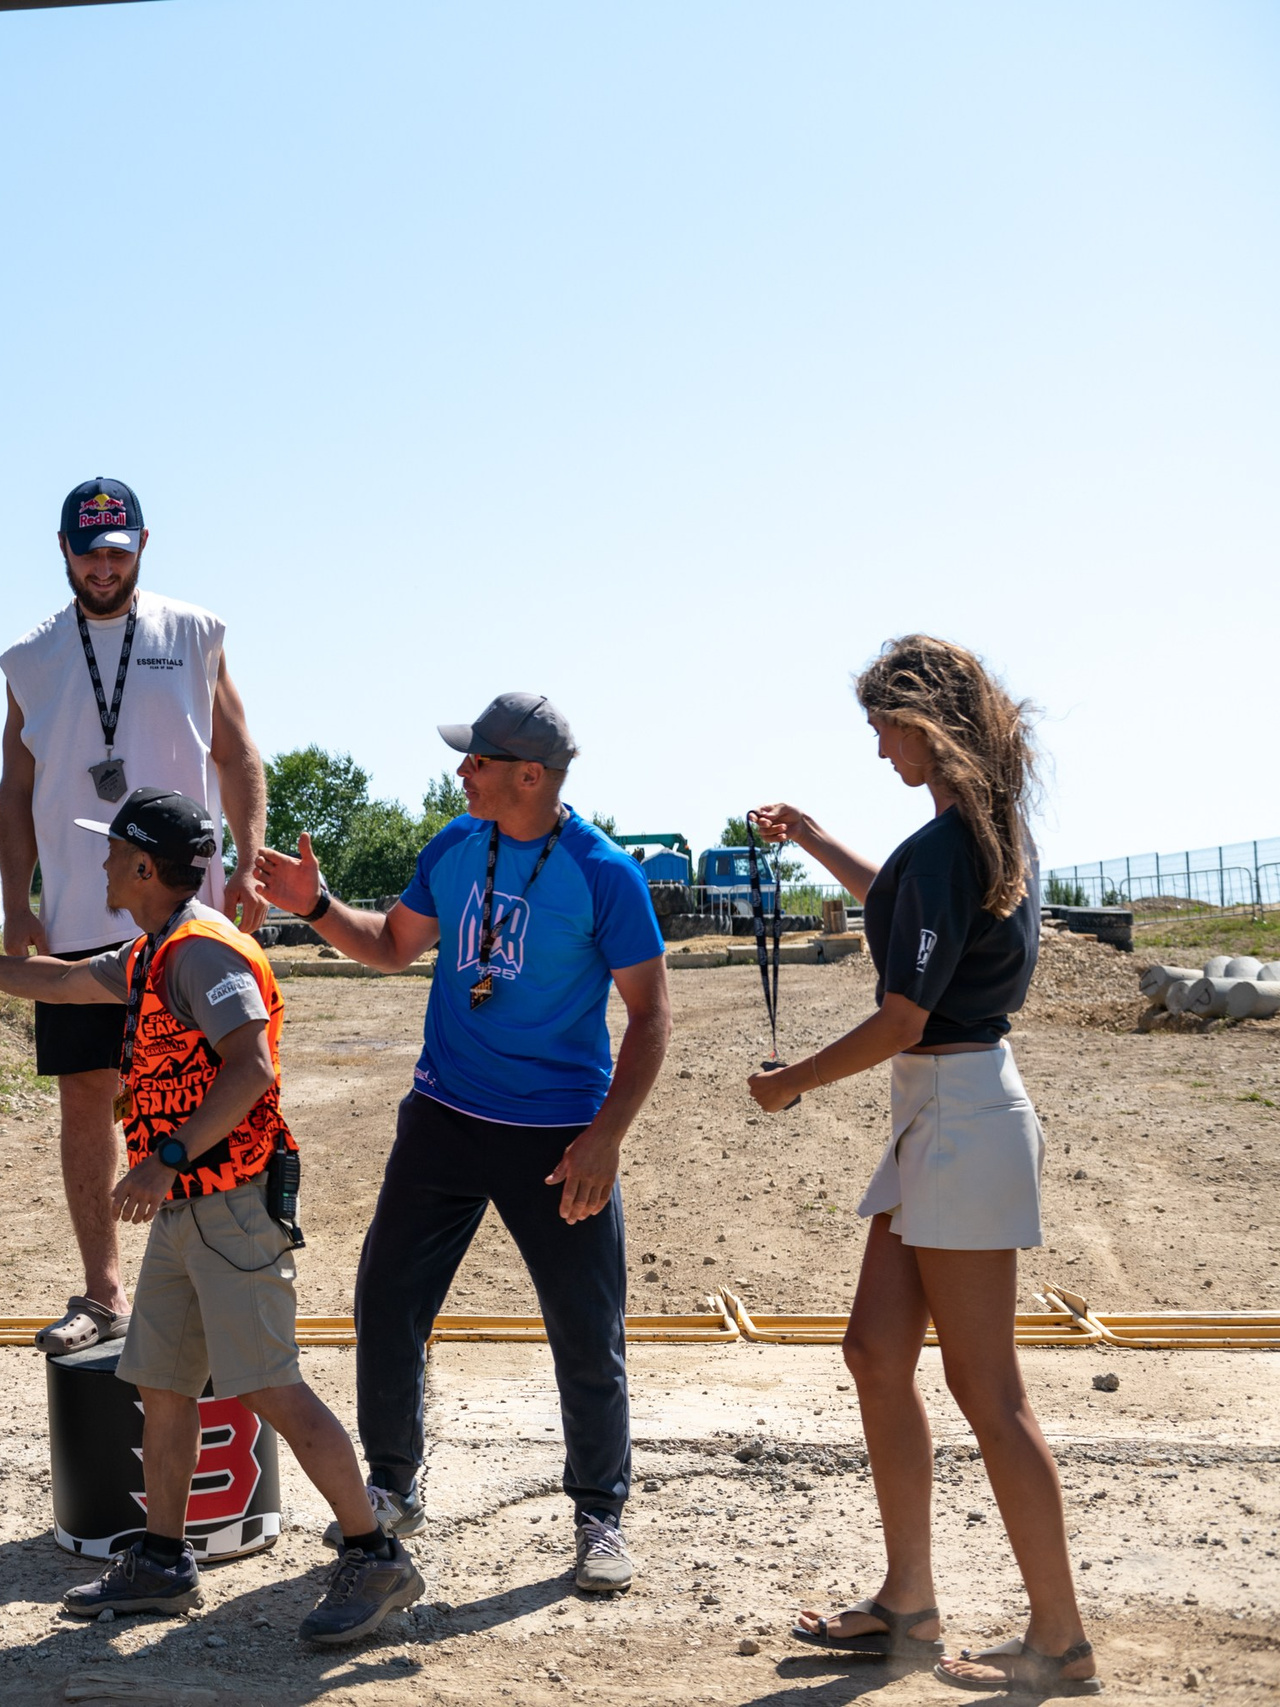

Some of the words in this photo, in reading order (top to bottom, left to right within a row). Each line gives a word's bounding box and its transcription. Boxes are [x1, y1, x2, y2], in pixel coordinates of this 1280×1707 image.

[79, 512, 102, 528] Red
[103, 511, 126, 526] Bull
[136, 658, 183, 666] ESSENTIALS
[148, 1012, 174, 1023] END
[143, 1019, 187, 1038] SAK
[140, 1066, 217, 1091] ENDURO
[136, 1085, 204, 1115] SAKH
